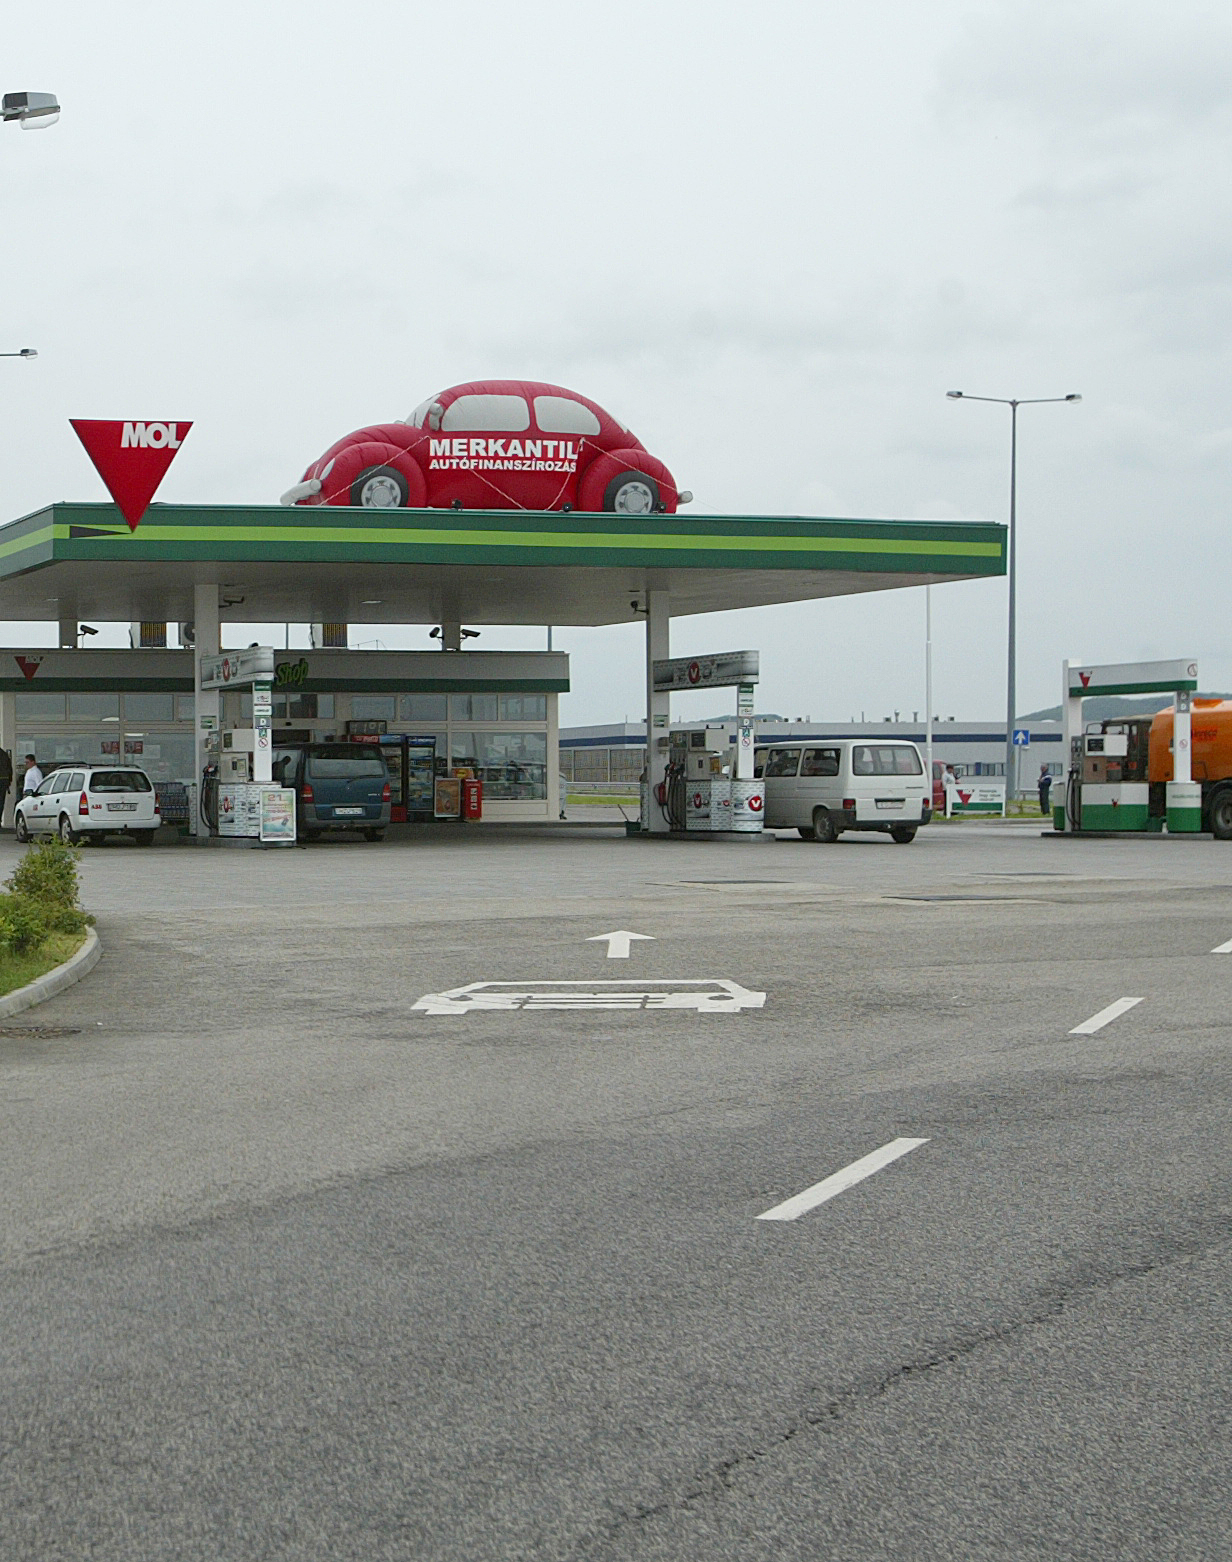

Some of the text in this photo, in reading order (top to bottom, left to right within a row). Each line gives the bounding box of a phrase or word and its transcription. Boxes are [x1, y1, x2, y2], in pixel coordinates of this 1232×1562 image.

[120, 422, 183, 450] MOL
[429, 438, 579, 460] MERKANTIL
[428, 457, 577, 473] AUTÓFINANSZÍROZÁS
[275, 658, 309, 686] Shop
